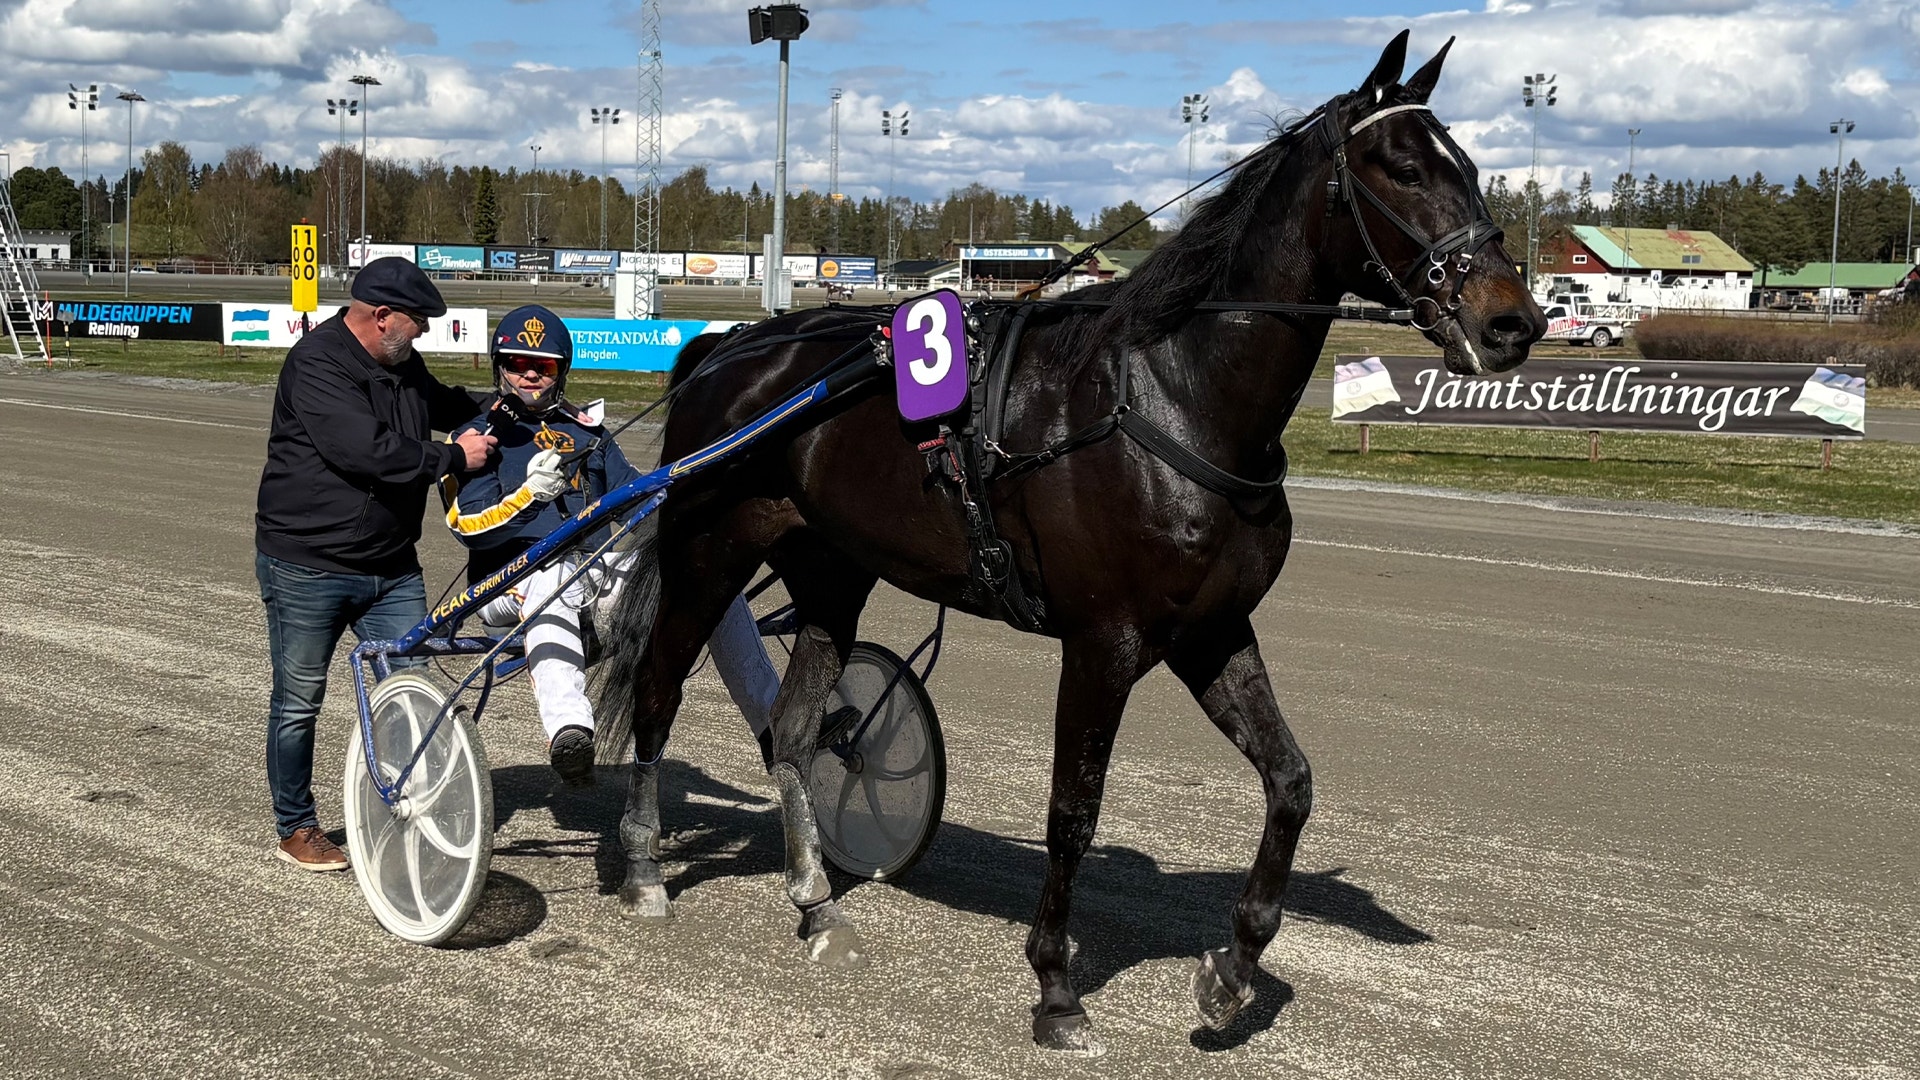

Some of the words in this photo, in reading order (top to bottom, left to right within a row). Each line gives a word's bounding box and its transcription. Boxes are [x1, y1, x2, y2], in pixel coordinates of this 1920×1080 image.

[671, 257, 683, 265] EL
[88, 321, 140, 339] Relining
[906, 299, 952, 386] 3
[577, 347, 621, 362] längden.
[1405, 365, 1791, 432] Jämtställningar
[431, 588, 472, 624] PEAK
[473, 568, 507, 598] SPRINT
[507, 552, 529, 576] FLEX
